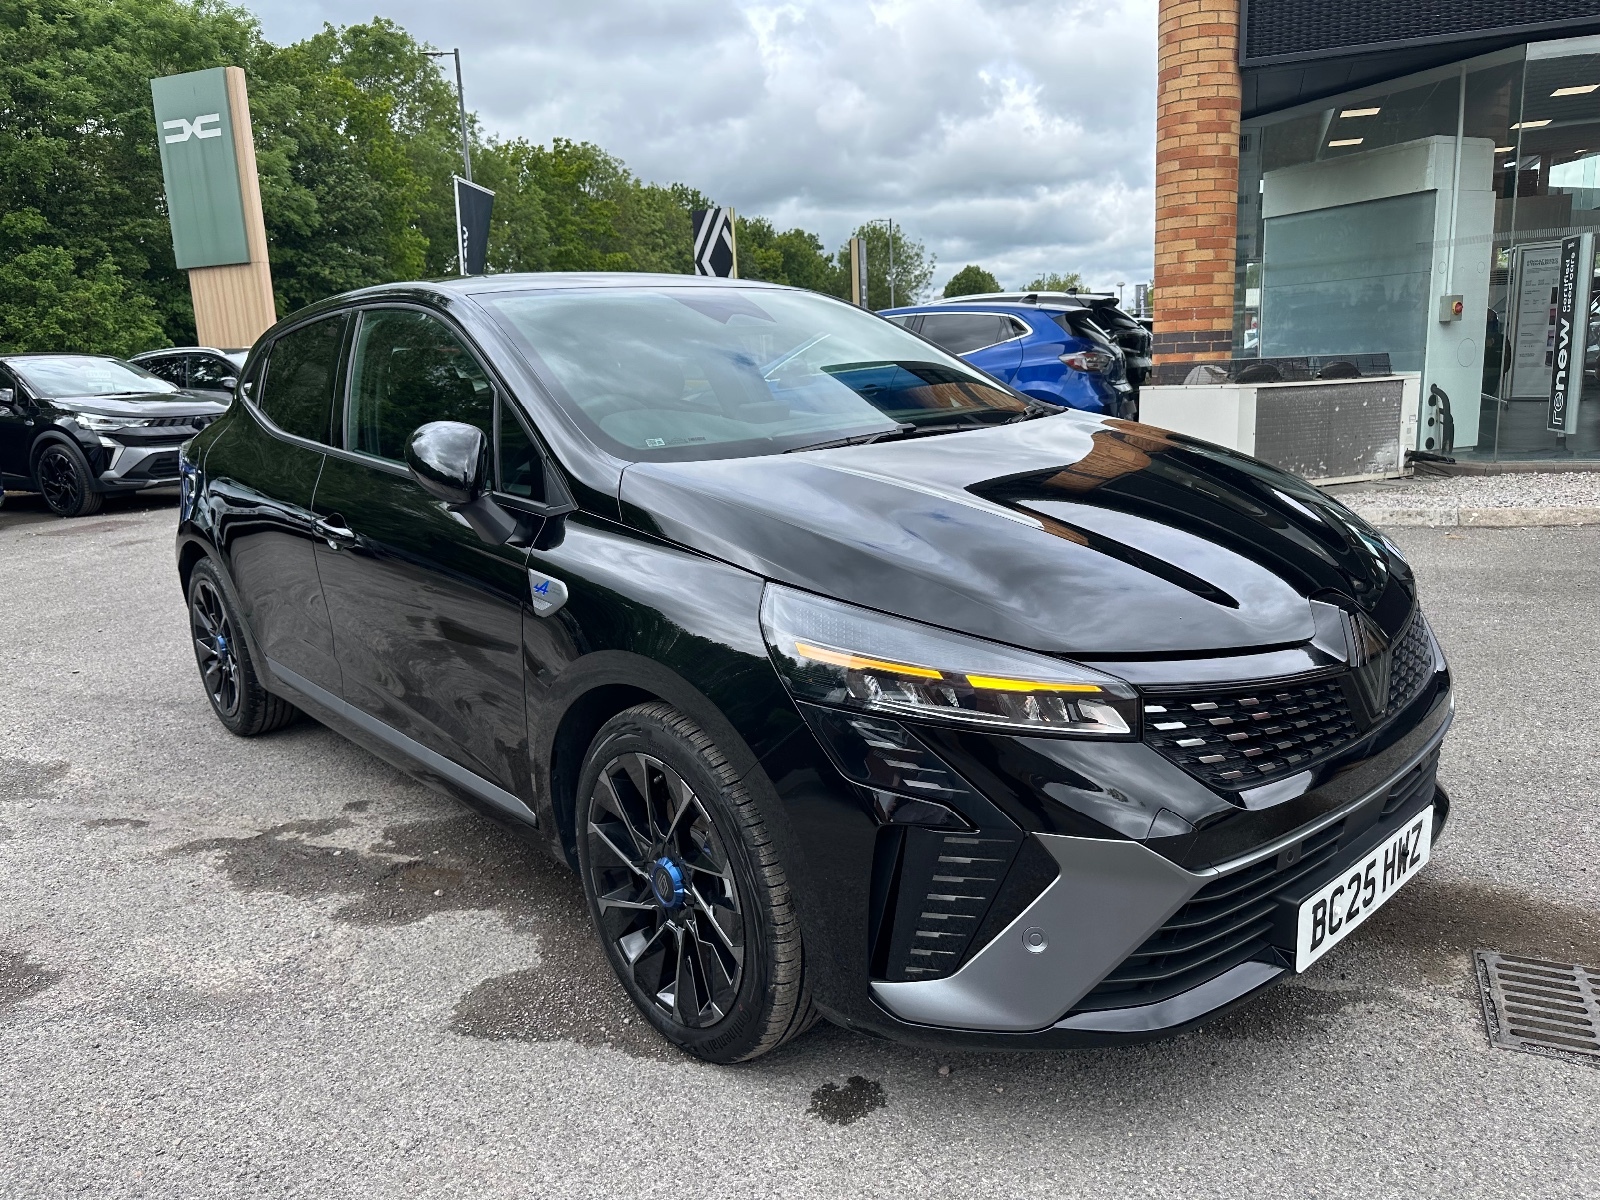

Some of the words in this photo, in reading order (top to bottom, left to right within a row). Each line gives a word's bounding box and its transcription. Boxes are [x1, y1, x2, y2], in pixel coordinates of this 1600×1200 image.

[1562, 259, 1570, 312] certified
[1552, 317, 1570, 426] renew
[1310, 858, 1377, 954] BC25
[1382, 818, 1424, 894] HWZ
